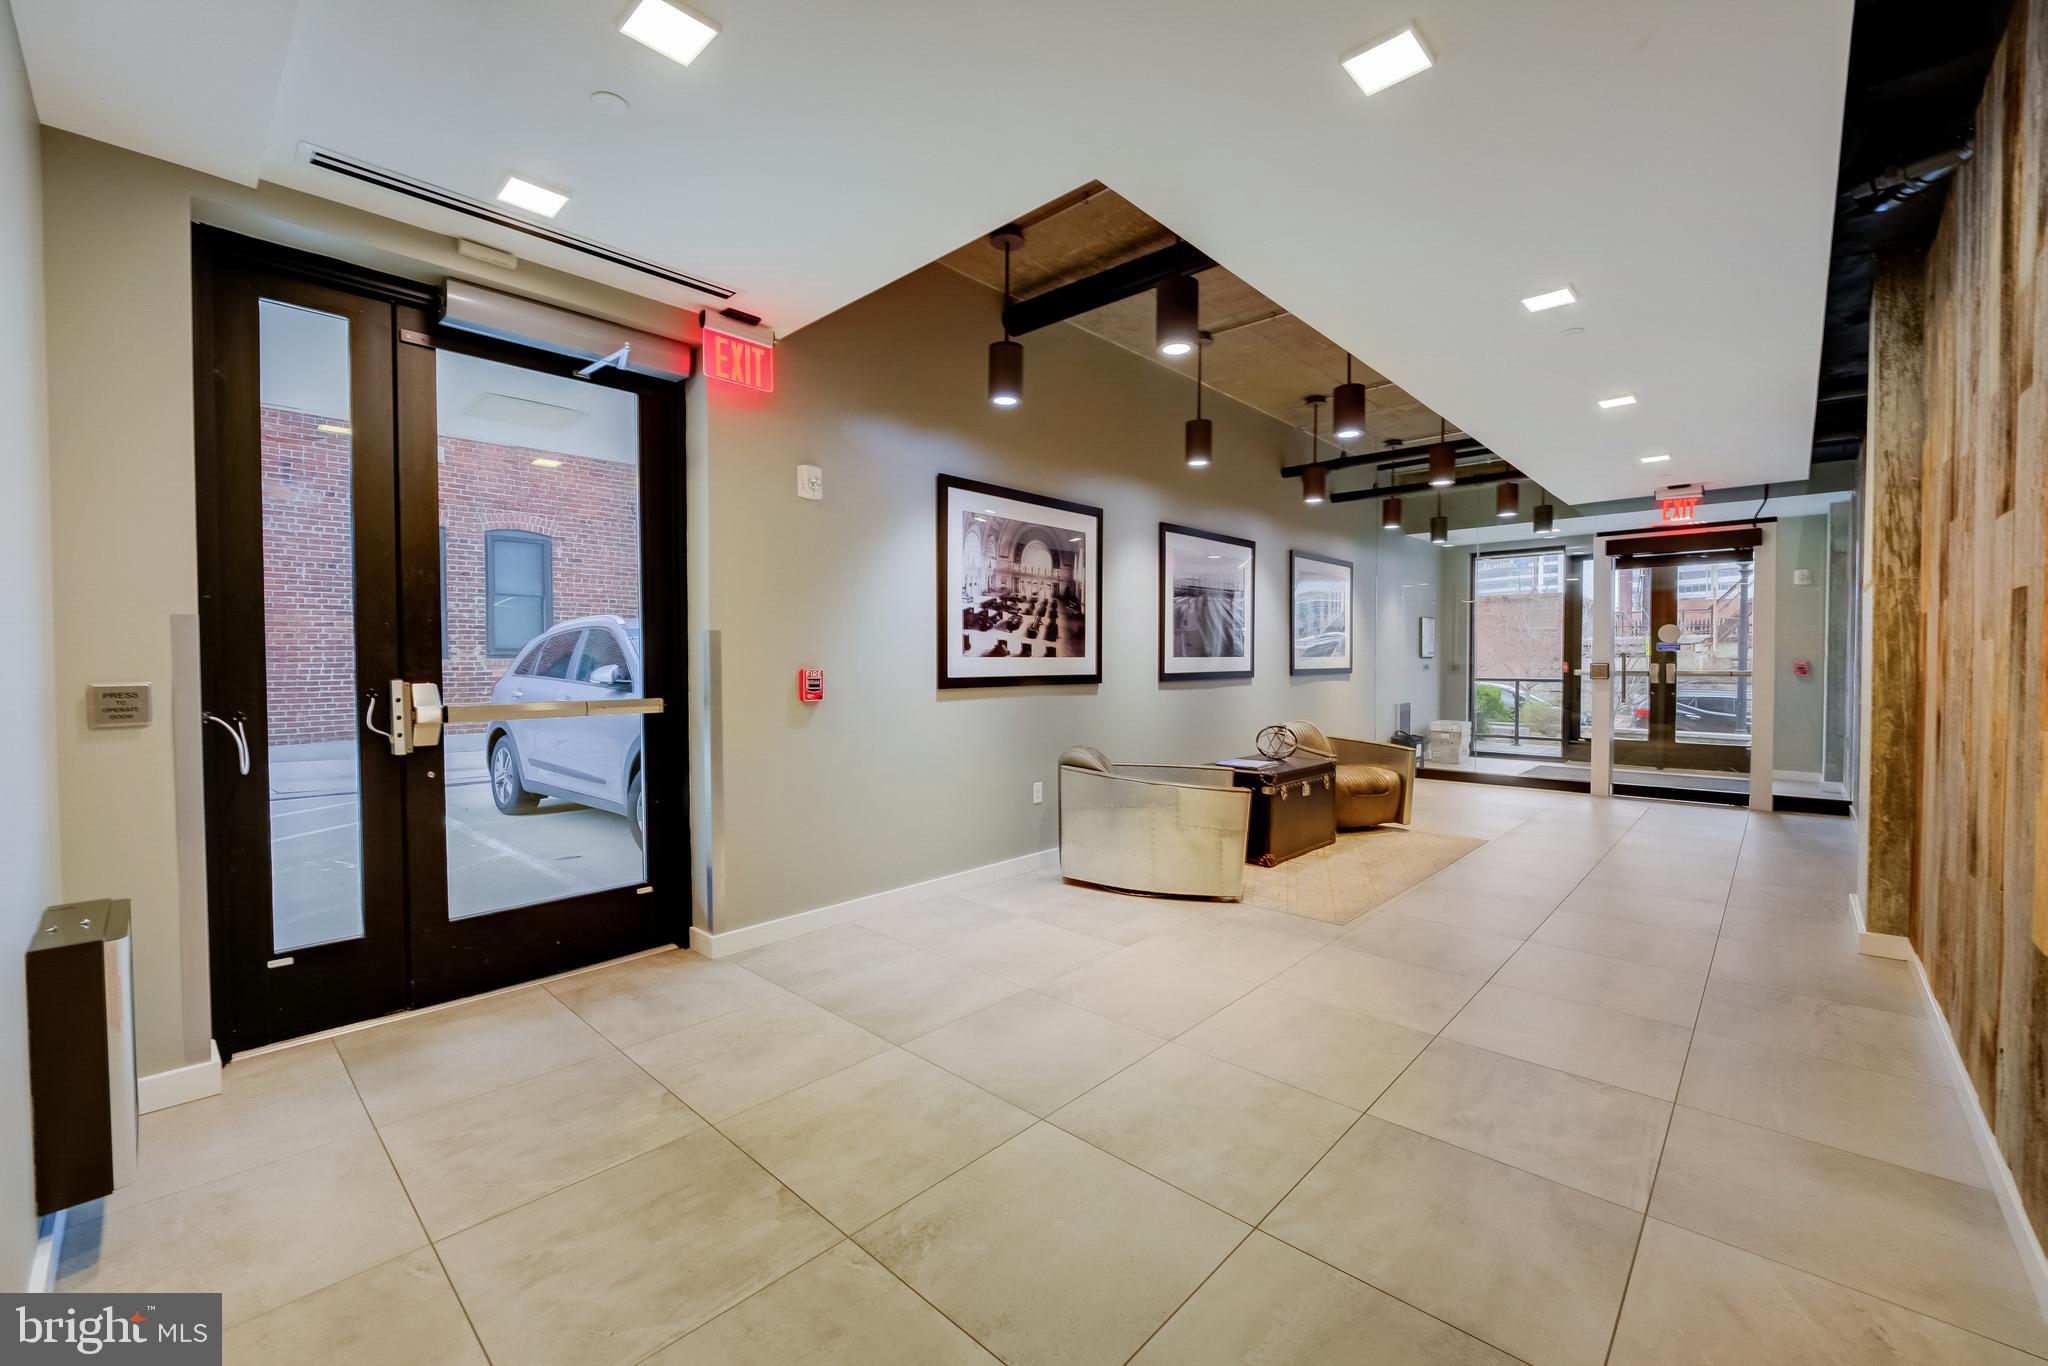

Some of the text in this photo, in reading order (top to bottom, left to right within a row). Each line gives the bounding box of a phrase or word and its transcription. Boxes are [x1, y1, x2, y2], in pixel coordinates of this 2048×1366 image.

[714, 335, 766, 388] EXIT
[1663, 498, 1697, 520] EXIT
[806, 670, 822, 678] FIRE
